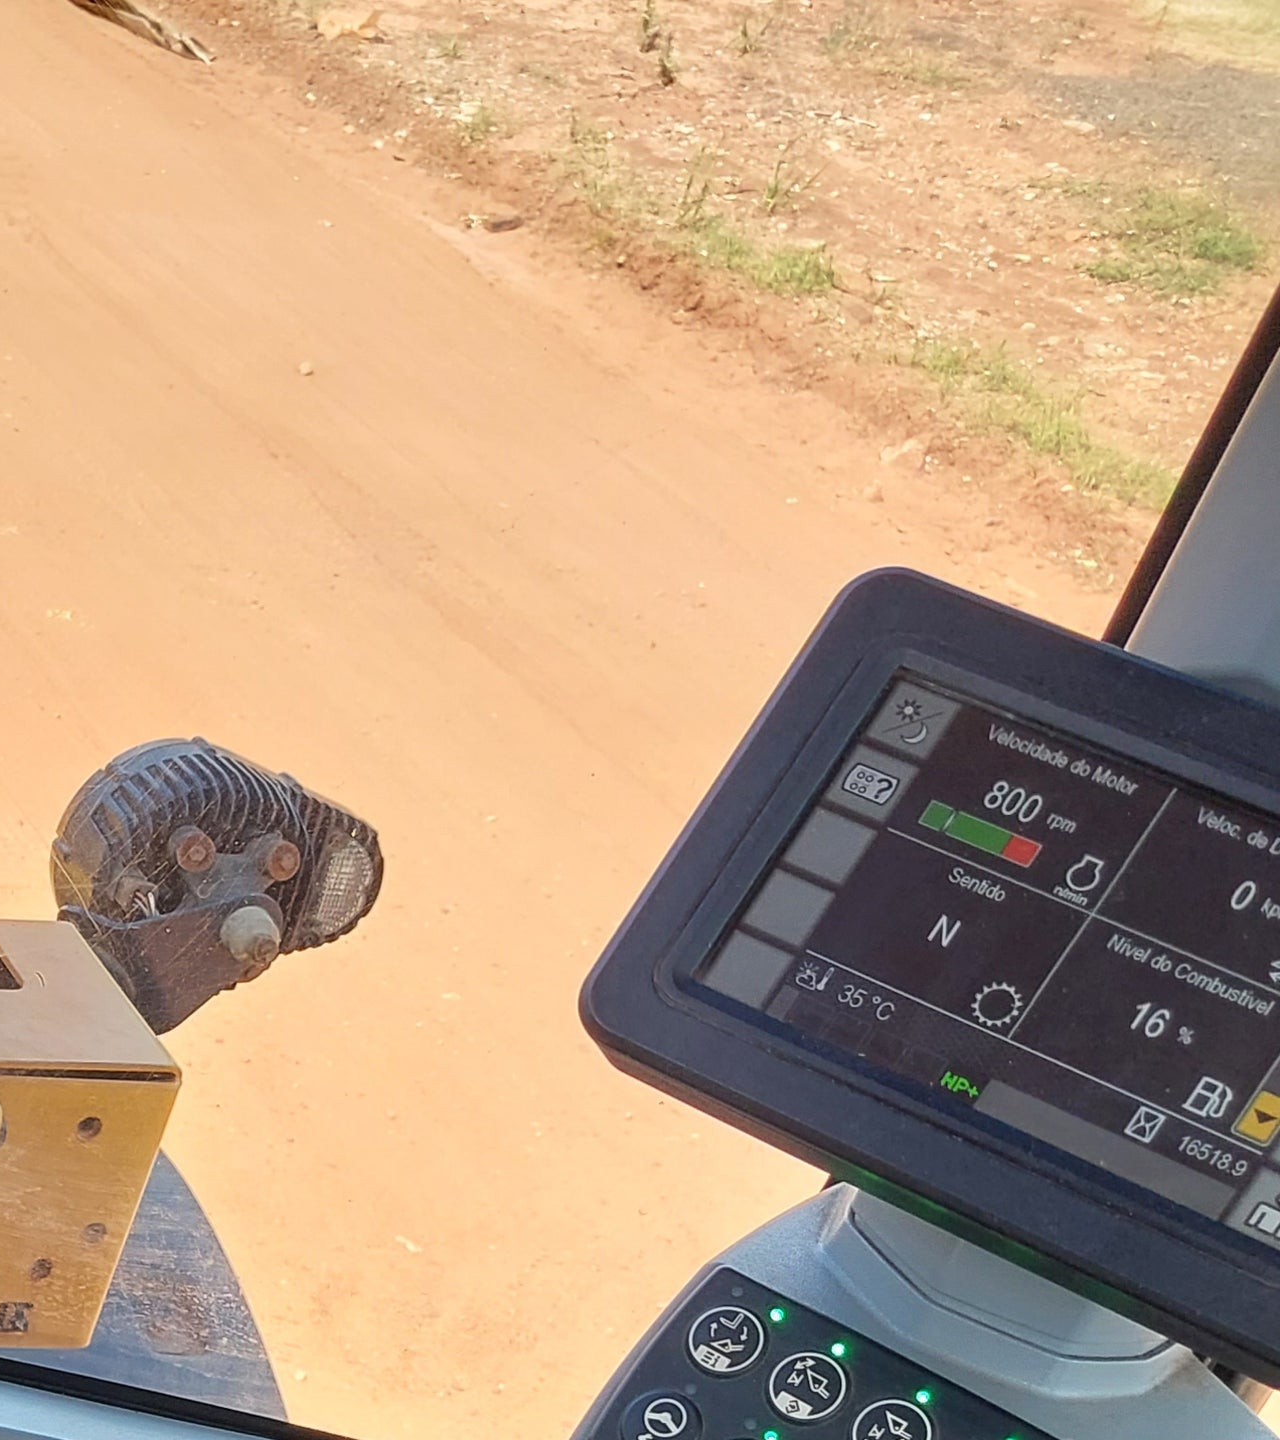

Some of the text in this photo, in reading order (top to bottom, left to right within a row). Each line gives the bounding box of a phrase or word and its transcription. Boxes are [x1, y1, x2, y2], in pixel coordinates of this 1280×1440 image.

[989, 723, 1139, 796] Velocidade do Motor
[983, 780, 1077, 833] 800 rpm
[1197, 806, 1241, 840] Veloc.
[1246, 830, 1268, 849] de
[948, 866, 1006, 902] Sentido
[1230, 880, 1280, 920] 0 kp
[927, 914, 962, 948] N
[1150, 954, 1172, 973] do
[837, 984, 896, 1021] 35 °C
[1130, 1002, 1195, 1045] 16 %
[940, 1070, 980, 1098] HP+
[1178, 1135, 1249, 1177] 16518.9
